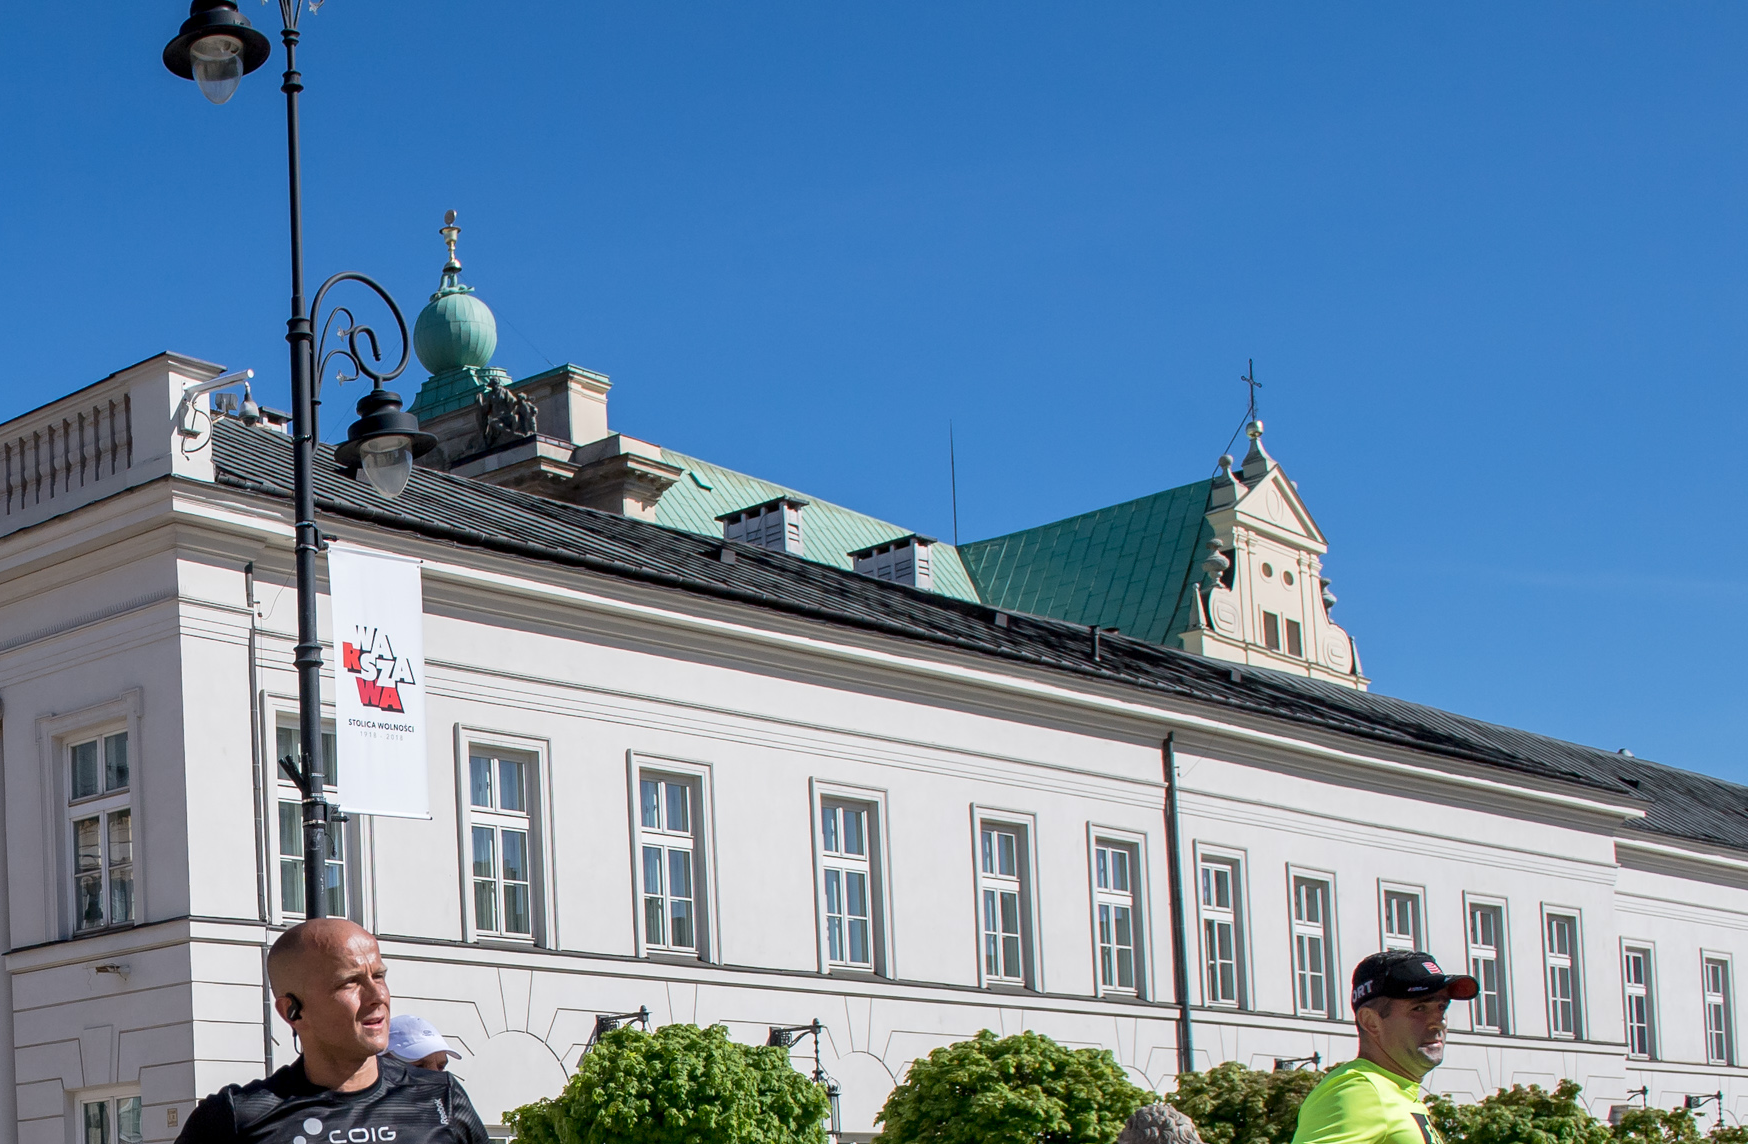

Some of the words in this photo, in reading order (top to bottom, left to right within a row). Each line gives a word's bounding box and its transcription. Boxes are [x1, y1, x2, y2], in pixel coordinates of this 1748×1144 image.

[348, 718, 376, 729] STOLICA
[377, 722, 415, 733] WOLNOŚCI
[360, 730, 377, 739] 1918
[386, 733, 404, 741] 2018
[1353, 980, 1373, 1003] ORT
[434, 1098, 449, 1125] Reebok
[328, 1126, 397, 1144] COIG
